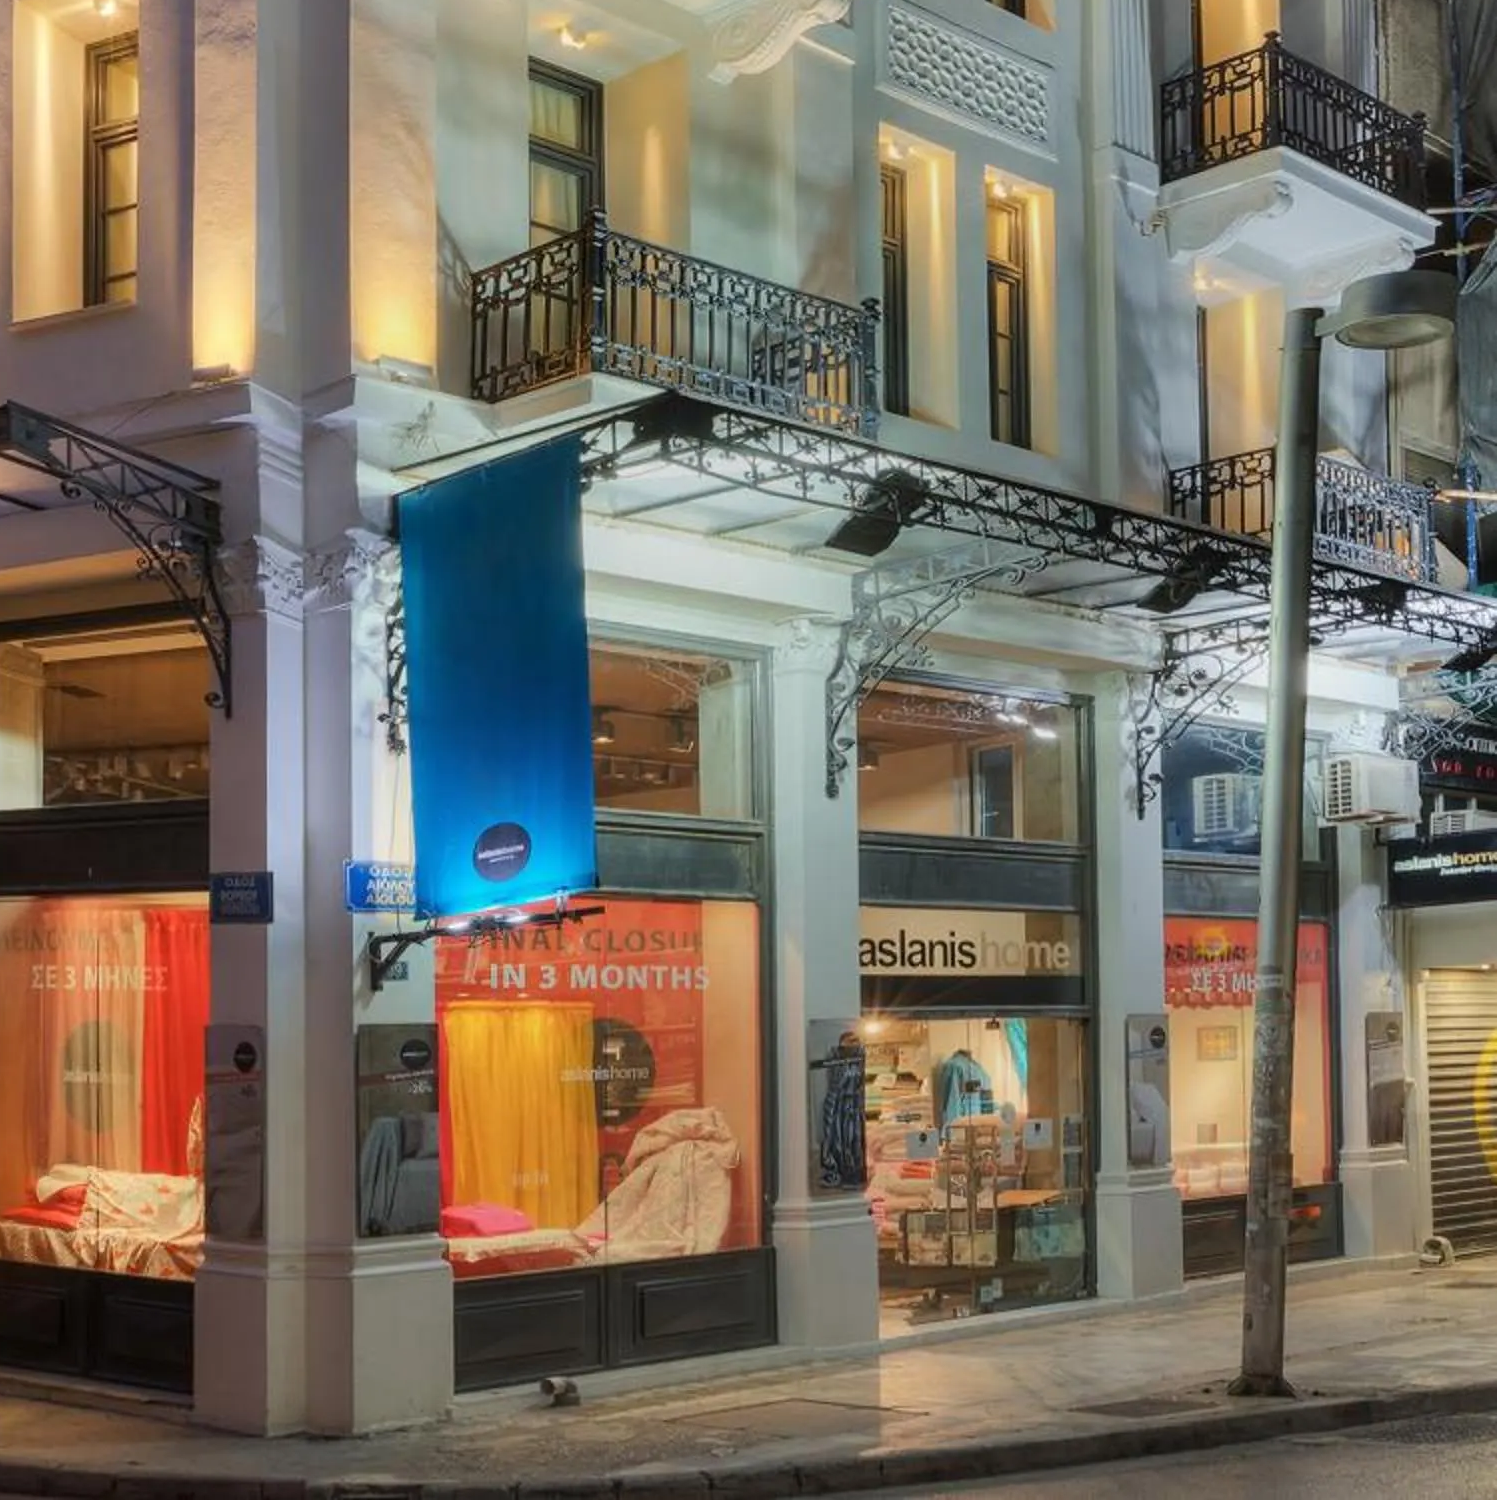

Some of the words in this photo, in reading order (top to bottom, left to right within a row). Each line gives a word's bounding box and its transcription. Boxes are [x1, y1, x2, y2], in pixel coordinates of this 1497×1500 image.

[471, 928, 569, 951] INAL
[31, 965, 57, 990] ΣΕ
[63, 965, 77, 990] 3
[84, 965, 169, 991] ΜΗΝΕΣ
[490, 963, 527, 990] IN
[539, 964, 558, 989] 3
[570, 963, 711, 991] MONTHS
